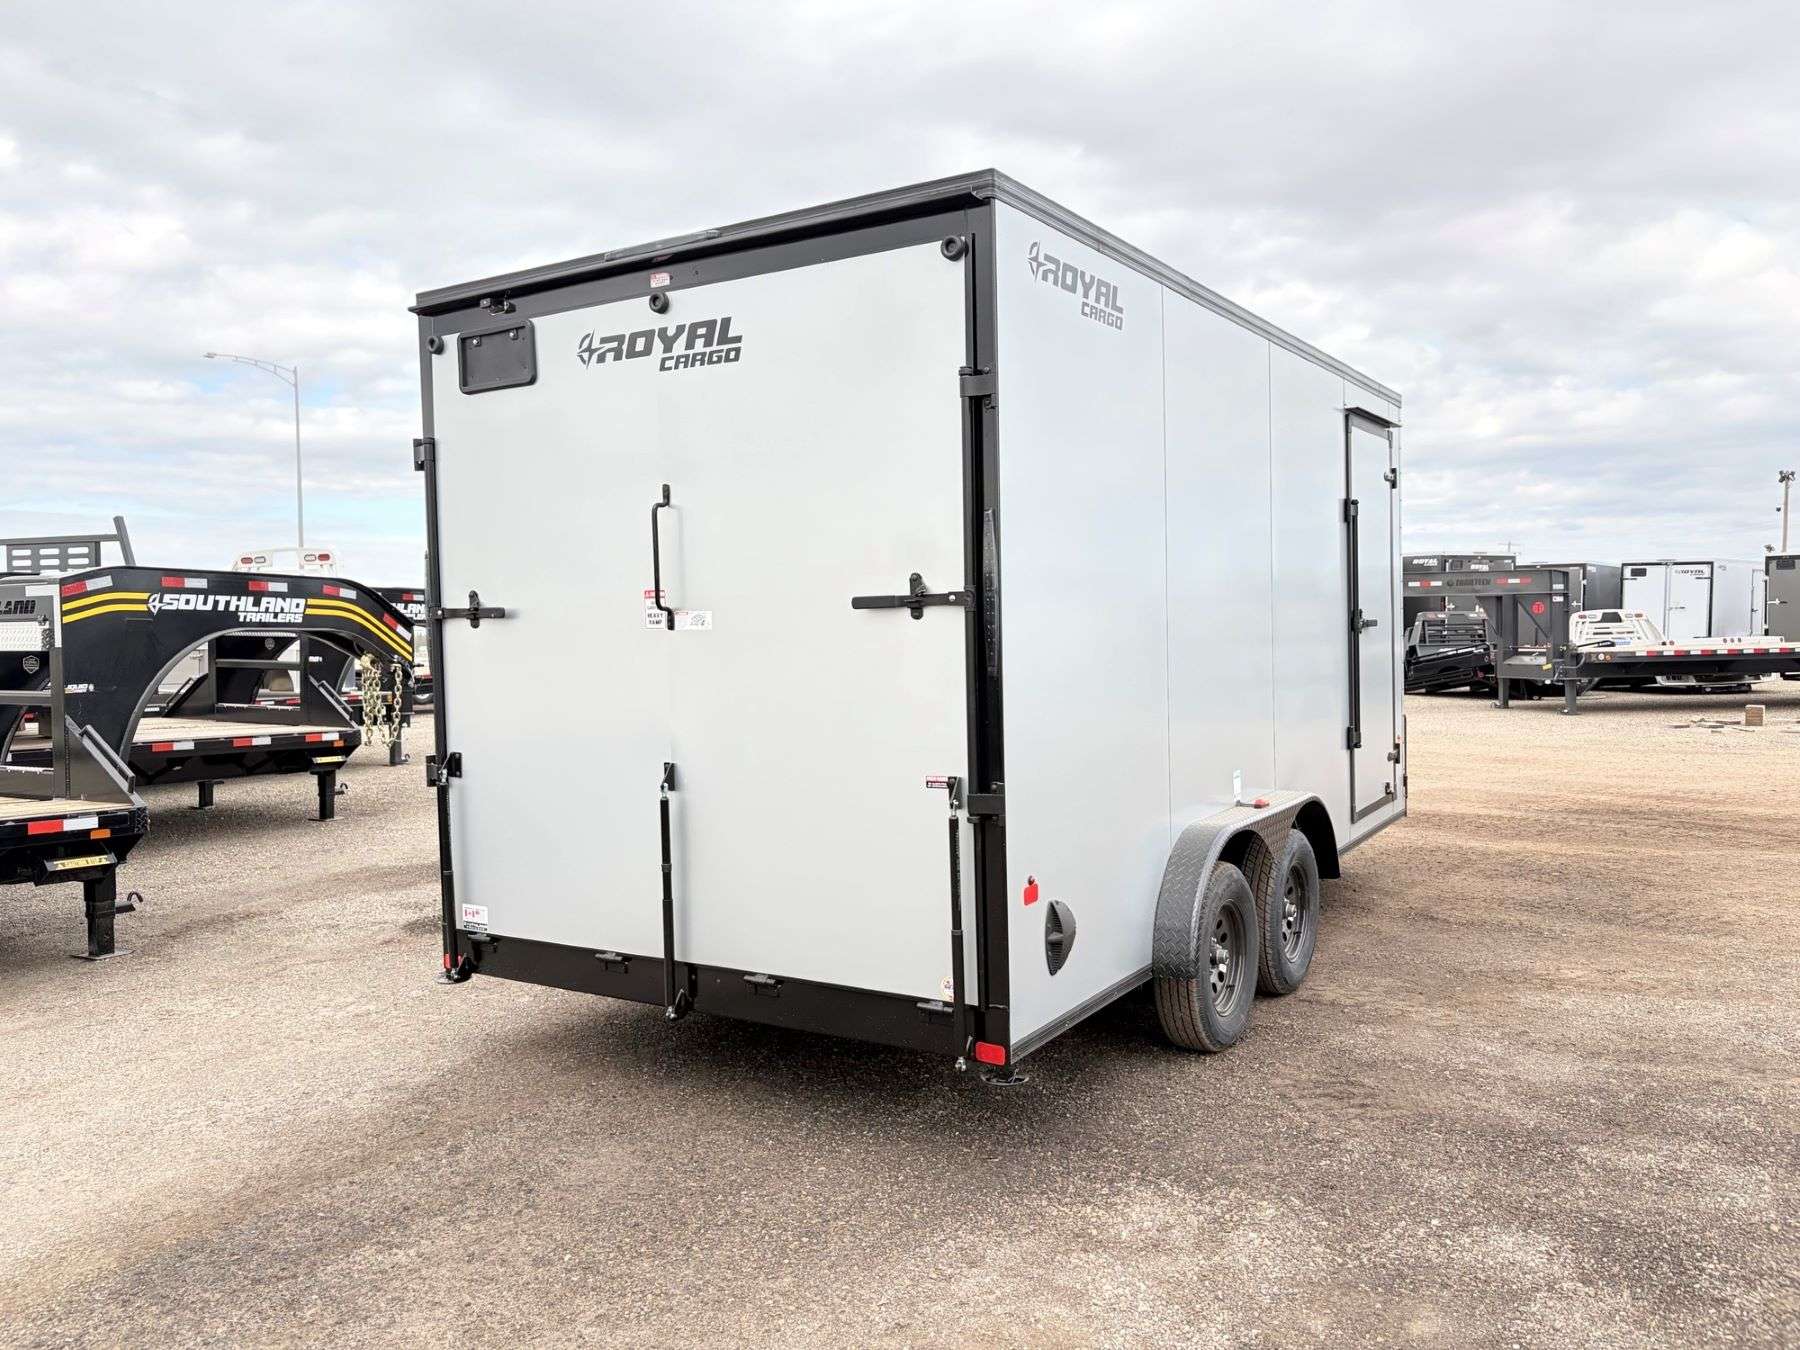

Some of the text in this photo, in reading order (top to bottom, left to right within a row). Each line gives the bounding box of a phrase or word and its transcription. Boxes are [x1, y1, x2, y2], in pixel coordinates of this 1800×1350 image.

[1041, 253, 1124, 314] ROYAL
[1081, 301, 1124, 331] CARGO
[596, 316, 743, 364] ROYAL
[659, 346, 742, 372] CARGO
[161, 593, 306, 613] SOUTHLAND
[238, 611, 304, 623] TRAILERS
